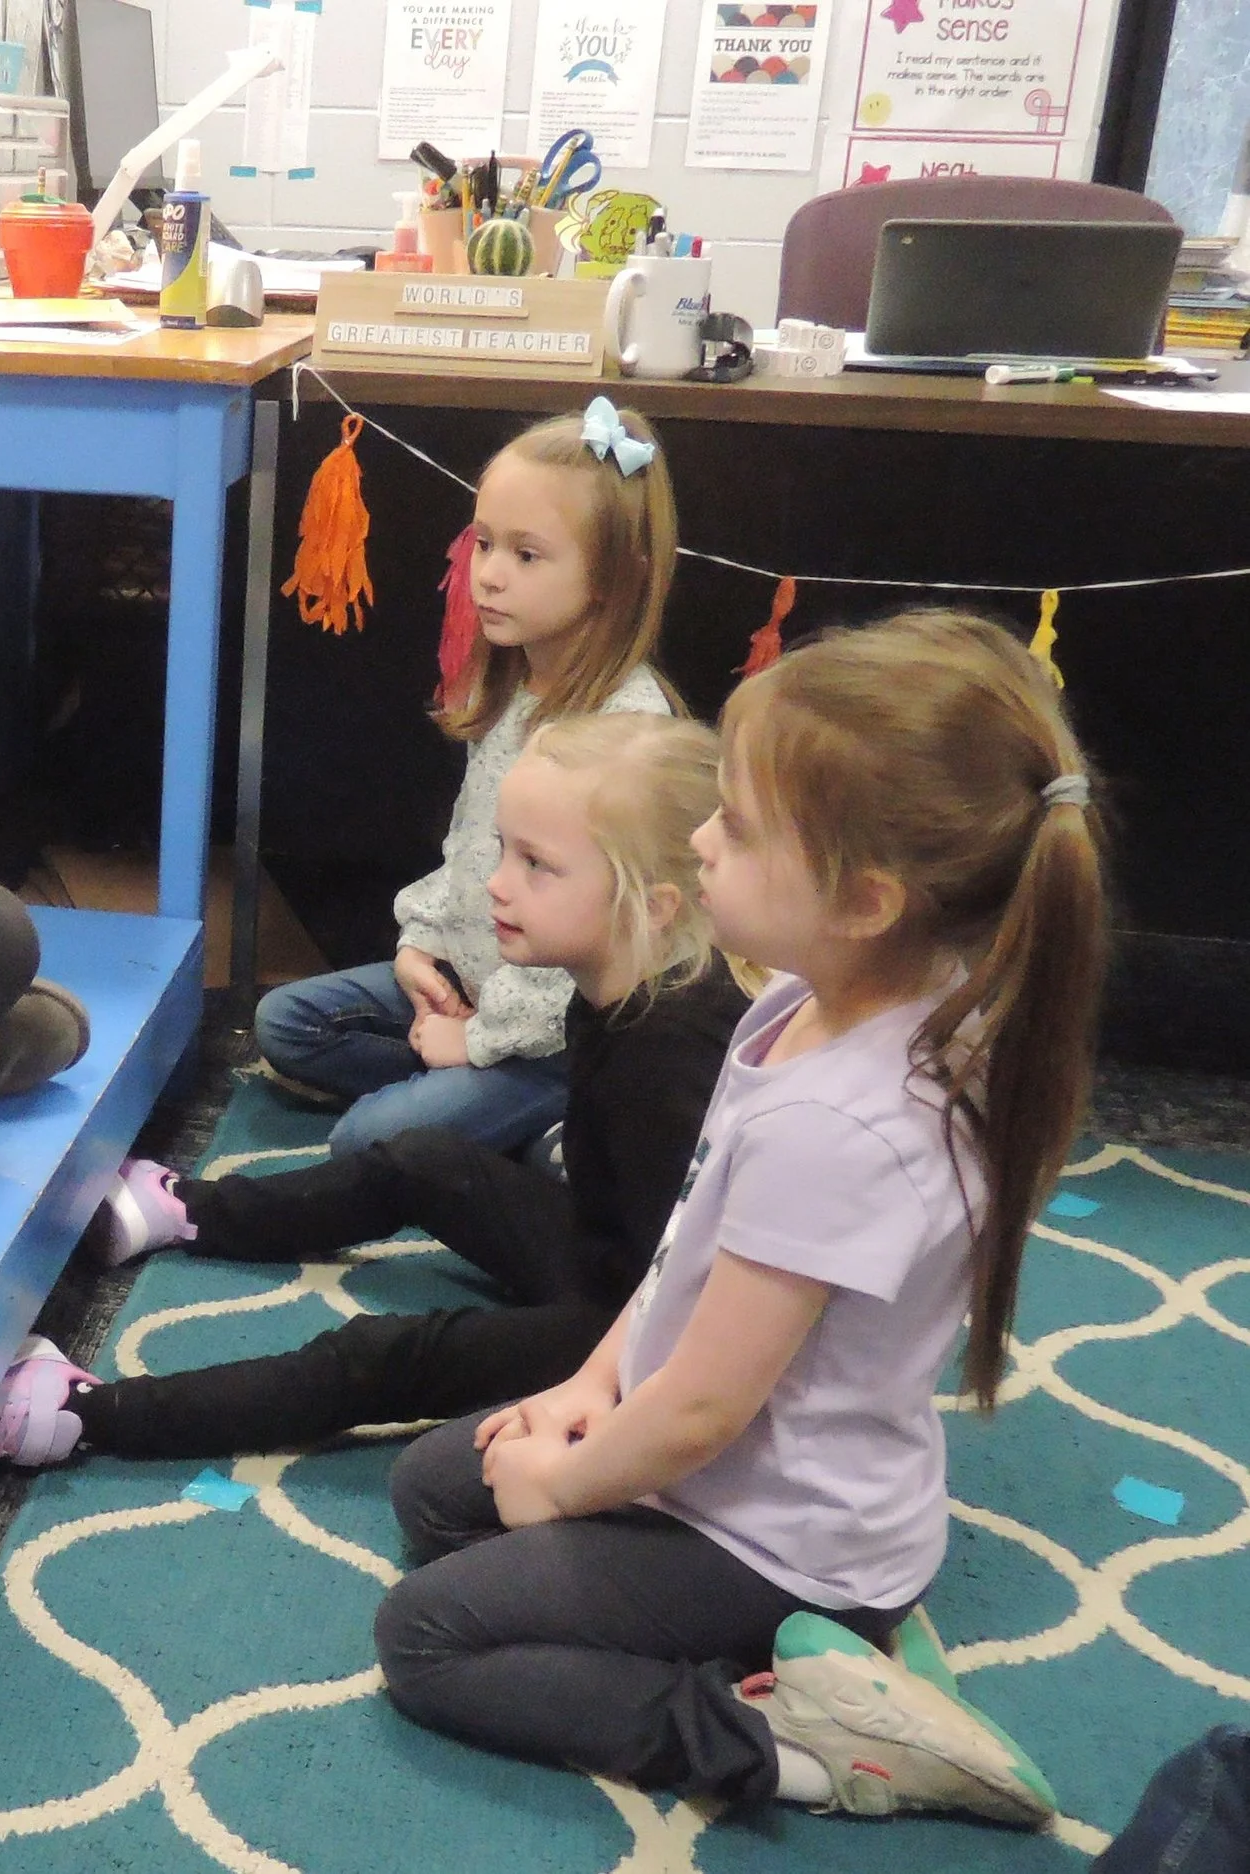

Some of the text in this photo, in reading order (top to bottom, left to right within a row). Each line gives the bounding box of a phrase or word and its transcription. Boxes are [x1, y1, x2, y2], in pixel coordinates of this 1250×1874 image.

[402, 5, 495, 15] YOU ARE MAKING
[411, 17, 484, 26] A DIFFERENCE
[936, 17, 1010, 43] sense
[411, 27, 484, 50] EVERY
[575, 35, 618, 57] YOU
[714, 38, 813, 54] THANK YOU
[423, 40, 471, 80] day
[896, 51, 903, 64] I
[905, 52, 933, 65] read
[934, 55, 954, 68] my
[956, 55, 1006, 67] sentence
[1009, 55, 1030, 67] and
[886, 68, 923, 80] makes
[963, 68, 983, 82] The
[987, 70, 1022, 83] words
[1024, 73, 1045, 83] are
[914, 86, 923, 96] in
[927, 84, 946, 97] the
[949, 85, 976, 99] right
[405, 287, 520, 307] WORLD'S
[331, 325, 586, 352] GREATEST TEACHER
